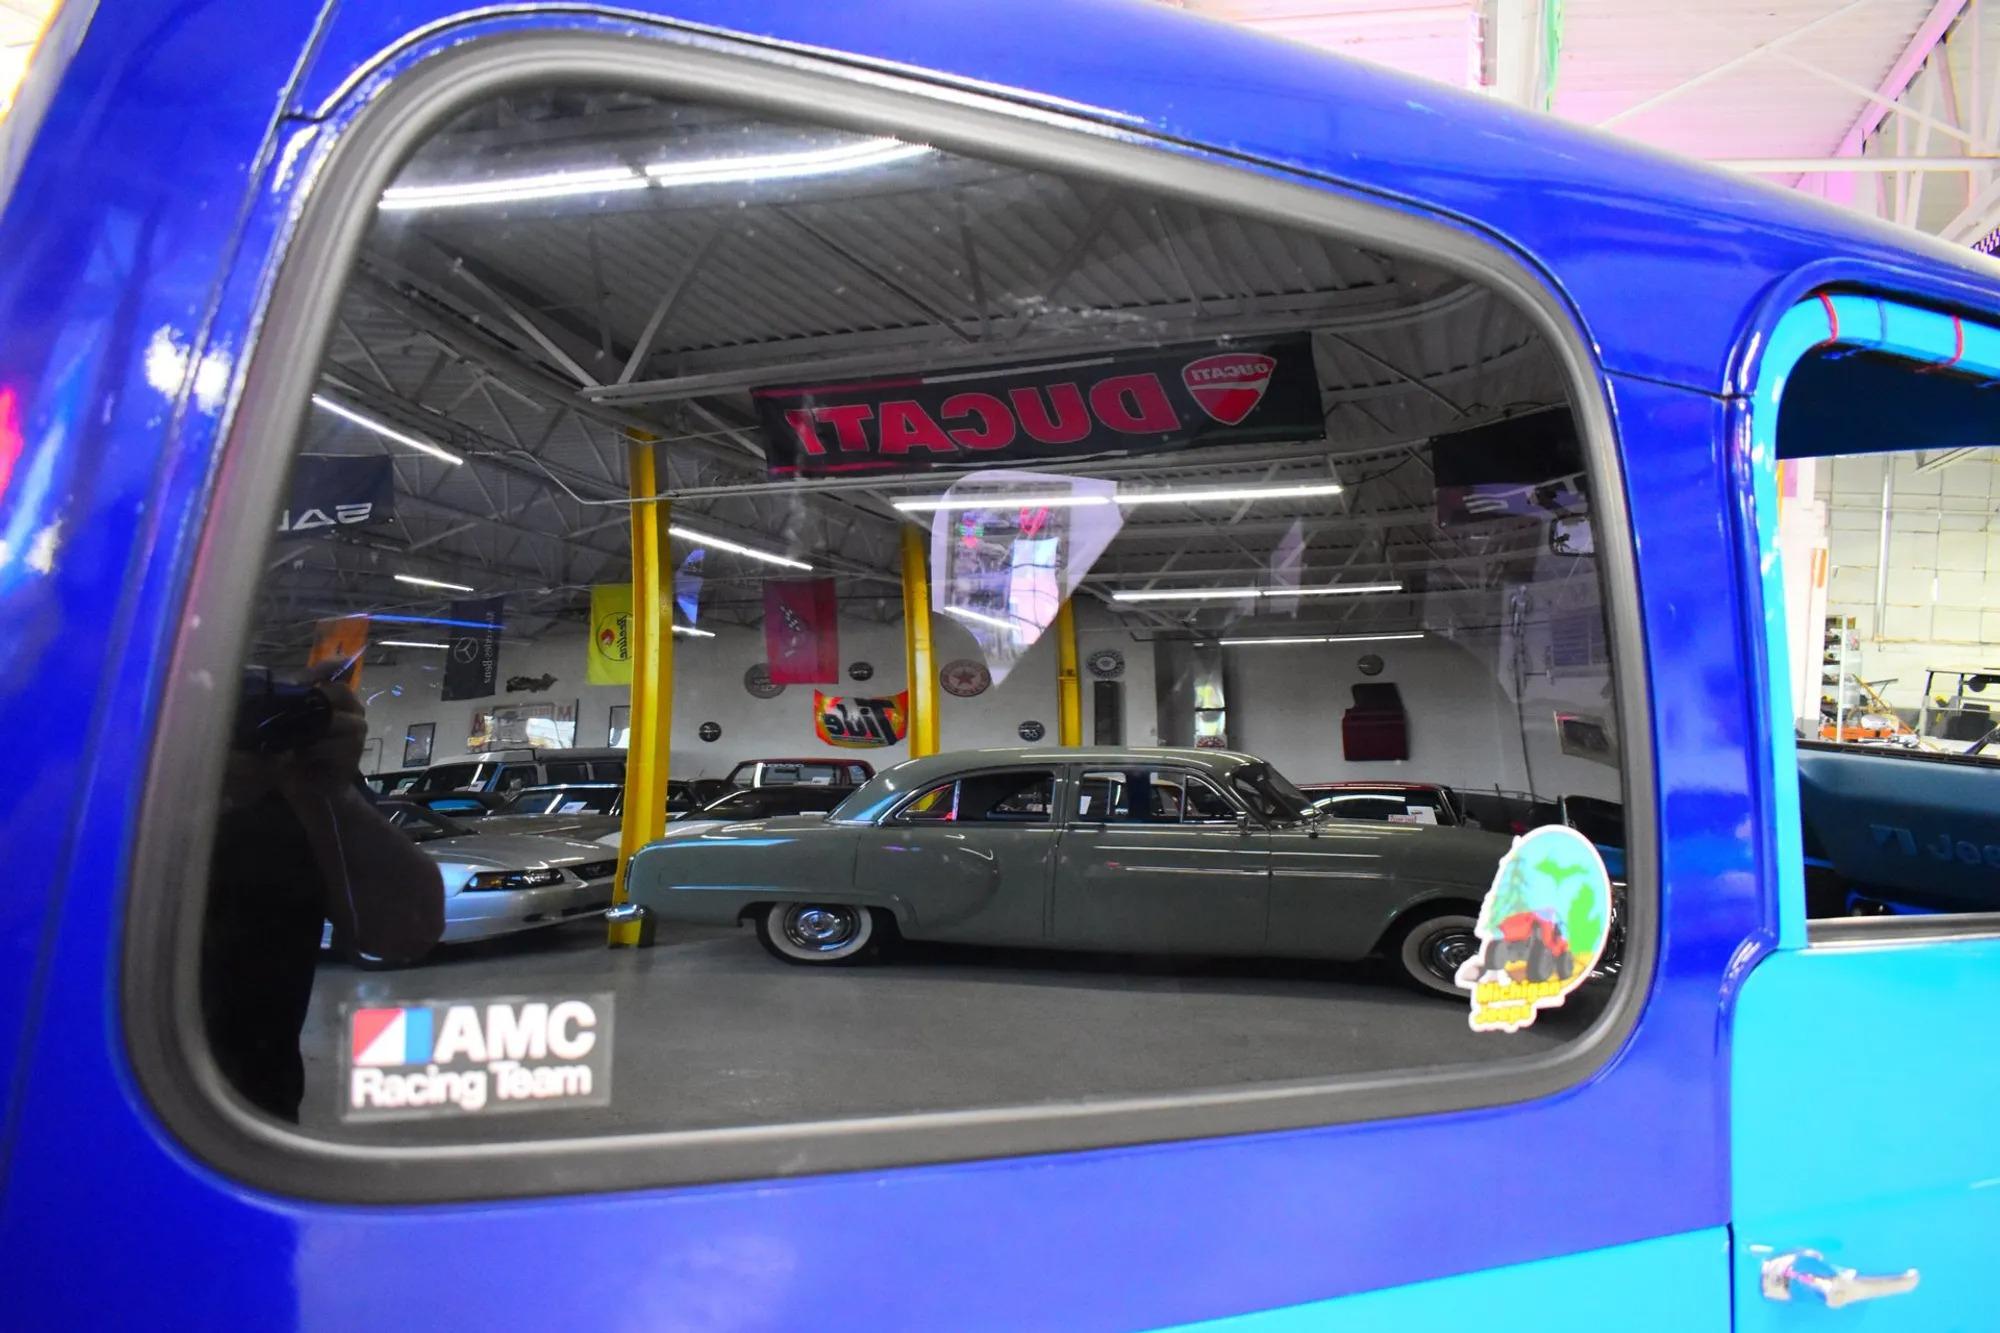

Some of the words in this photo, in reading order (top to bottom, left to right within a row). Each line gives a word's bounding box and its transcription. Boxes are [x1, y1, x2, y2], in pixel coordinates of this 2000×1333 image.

[433, 1000, 597, 1064] AMC
[351, 1064, 487, 1111] Racing
[488, 1060, 592, 1099] Team
